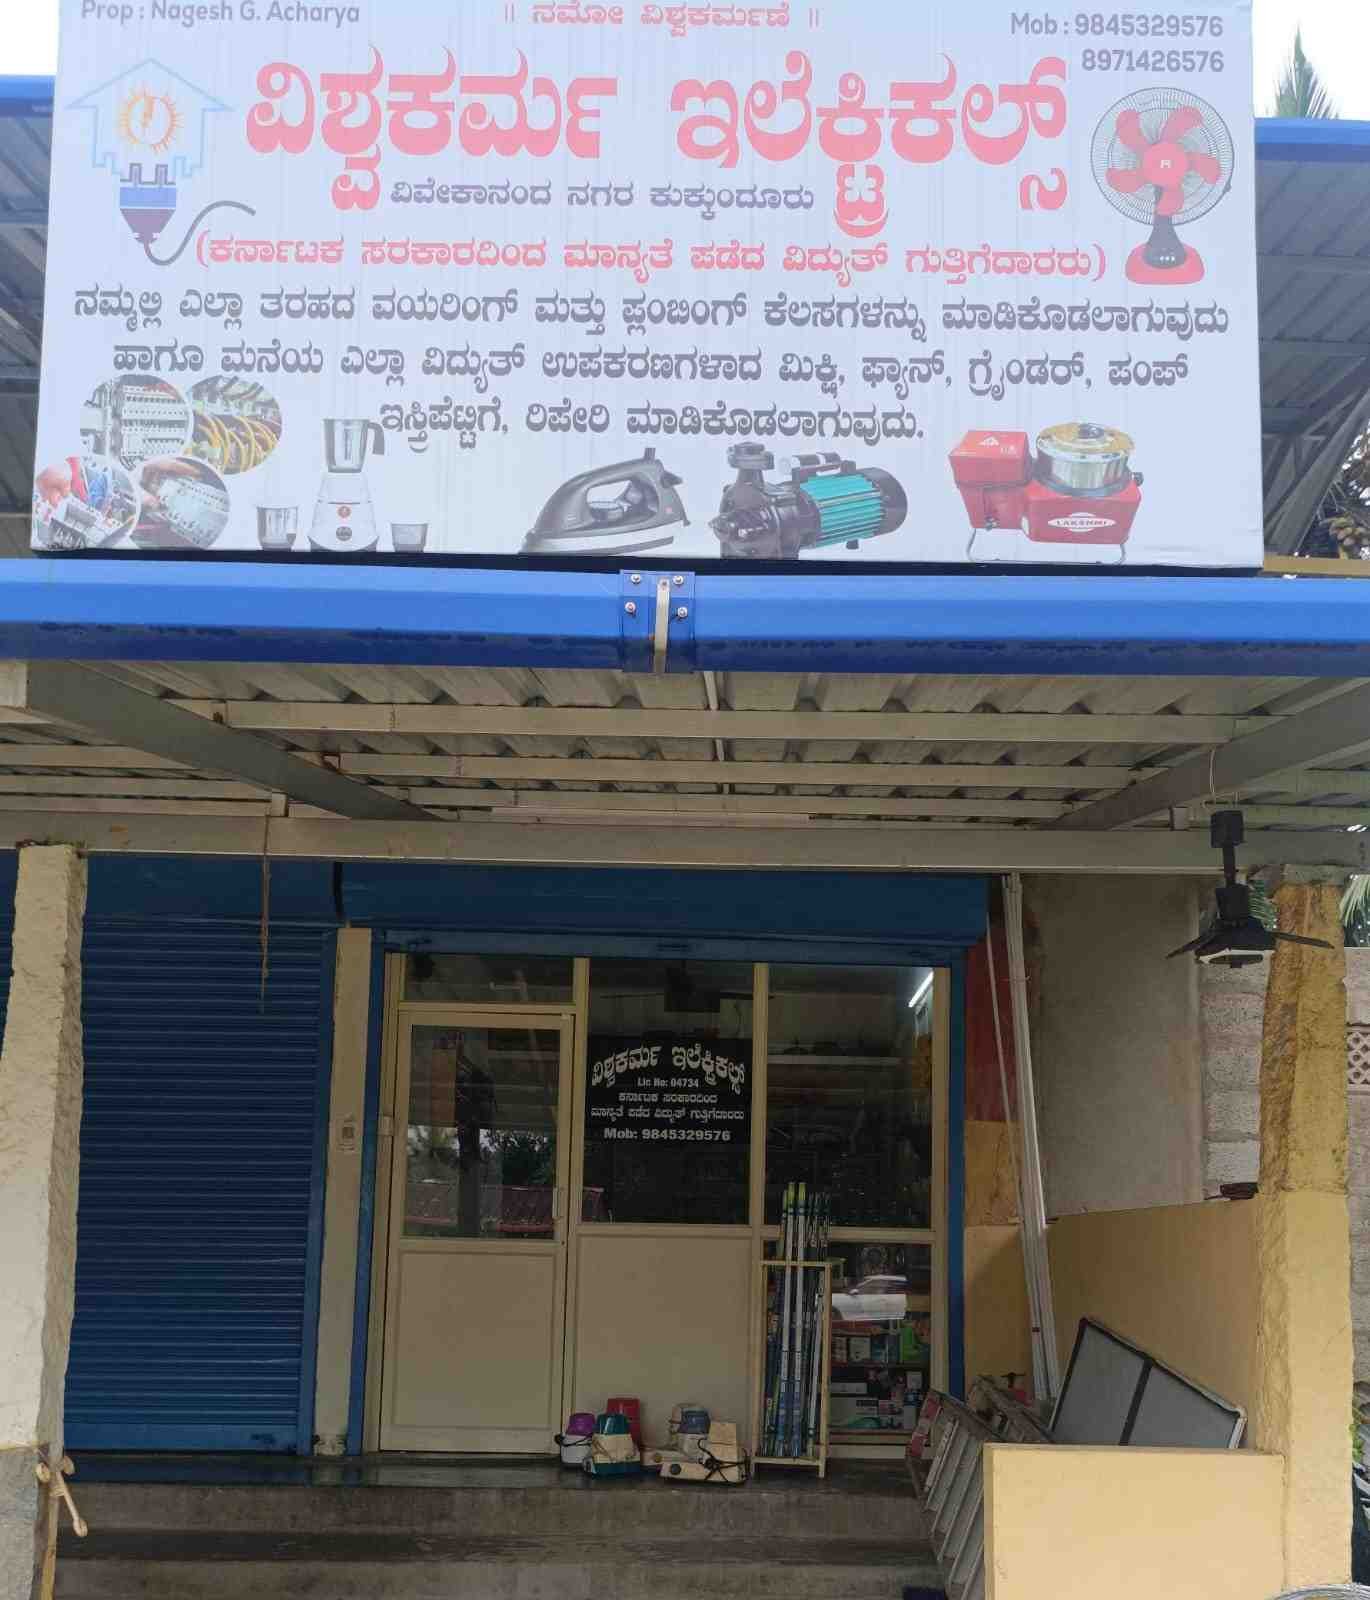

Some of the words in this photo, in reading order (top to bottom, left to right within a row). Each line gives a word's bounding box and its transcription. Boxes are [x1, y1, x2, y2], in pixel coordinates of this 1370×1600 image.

[81, 1, 133, 25] Prop
[151, 2, 233, 28] Nagesh
[240, 2, 260, 21] G.
[266, 3, 360, 29] Acharya
[1011, 12, 1056, 35] Mob
[1075, 13, 1223, 38] 9845329576
[1081, 49, 1224, 73] 8971426576
[245, 45, 617, 212] ವಿಶ್ವಕರ್ಮ
[672, 50, 1068, 239] ಇಲೆಕ್ಟ್ರಿಕಲ್ಸ್
[391, 177, 552, 205] ವಿವೇಕಾನಂದ
[568, 180, 634, 207] ನಗರ
[649, 182, 815, 220] ಕುಕ್ಕುಂದೂರು
[196, 229, 345, 268] (ಕರ್ನಾಟಕ
[361, 236, 547, 268] ಸರಕಾರದಿಂದ
[563, 237, 674, 284] ಮಾನ್ಯತೆ
[690, 240, 765, 271] ಪಡೆದ
[782, 242, 889, 288] ವಿದ್ಯುತ್
[905, 243, 1107, 285] ಗುತ್ತಿಗೆದಾರರು)
[74, 284, 163, 332] ನಮ್ಮಲ್ಲಿ
[179, 288, 243, 330] ಎಲ್ಲಾ
[259, 286, 356, 320] ತರಹದ
[372, 288, 519, 323] ವಯರಿಂಗ್
[534, 288, 606, 336] ಮತ್ತು
[622, 290, 747, 336] ಪ್ಲಂಬಿಂಗ್
[763, 291, 928, 344] ಕೆಲಸಗಳನ್ನು
[942, 295, 1229, 341] ಮಾಡಿಕೊಡಲಾಗುವುದು
[113, 338, 204, 371] ಹಾಗೂ
[220, 338, 324, 374] ಮನೆಯ
[340, 345, 405, 387] ಎಲ್ಲಾ
[421, 341, 526, 393] ವಿದ್ಯುತ್
[542, 344, 762, 381] ಉಪಕರಣಗಳಾದ
[861, 349, 952, 401] ಫ್ಯಾನ್,
[968, 349, 1092, 401] ಗ್ರೈಂಡರ್,
[1108, 352, 1189, 387] ಪಂಪ್
[379, 396, 509, 454] ಇಸ್ತ್ರಿಪೆಟ್ಟಿಗೆ,
[525, 397, 611, 434] ರಿಪೇರಿ
[626, 399, 924, 446] ಮಾಡಿಕೊಡಲಾಗುವುದು.
[670, 1078, 700, 1088] 04734
[604, 1128, 638, 1140] Mob:
[642, 1128, 731, 1141] 9845329576
